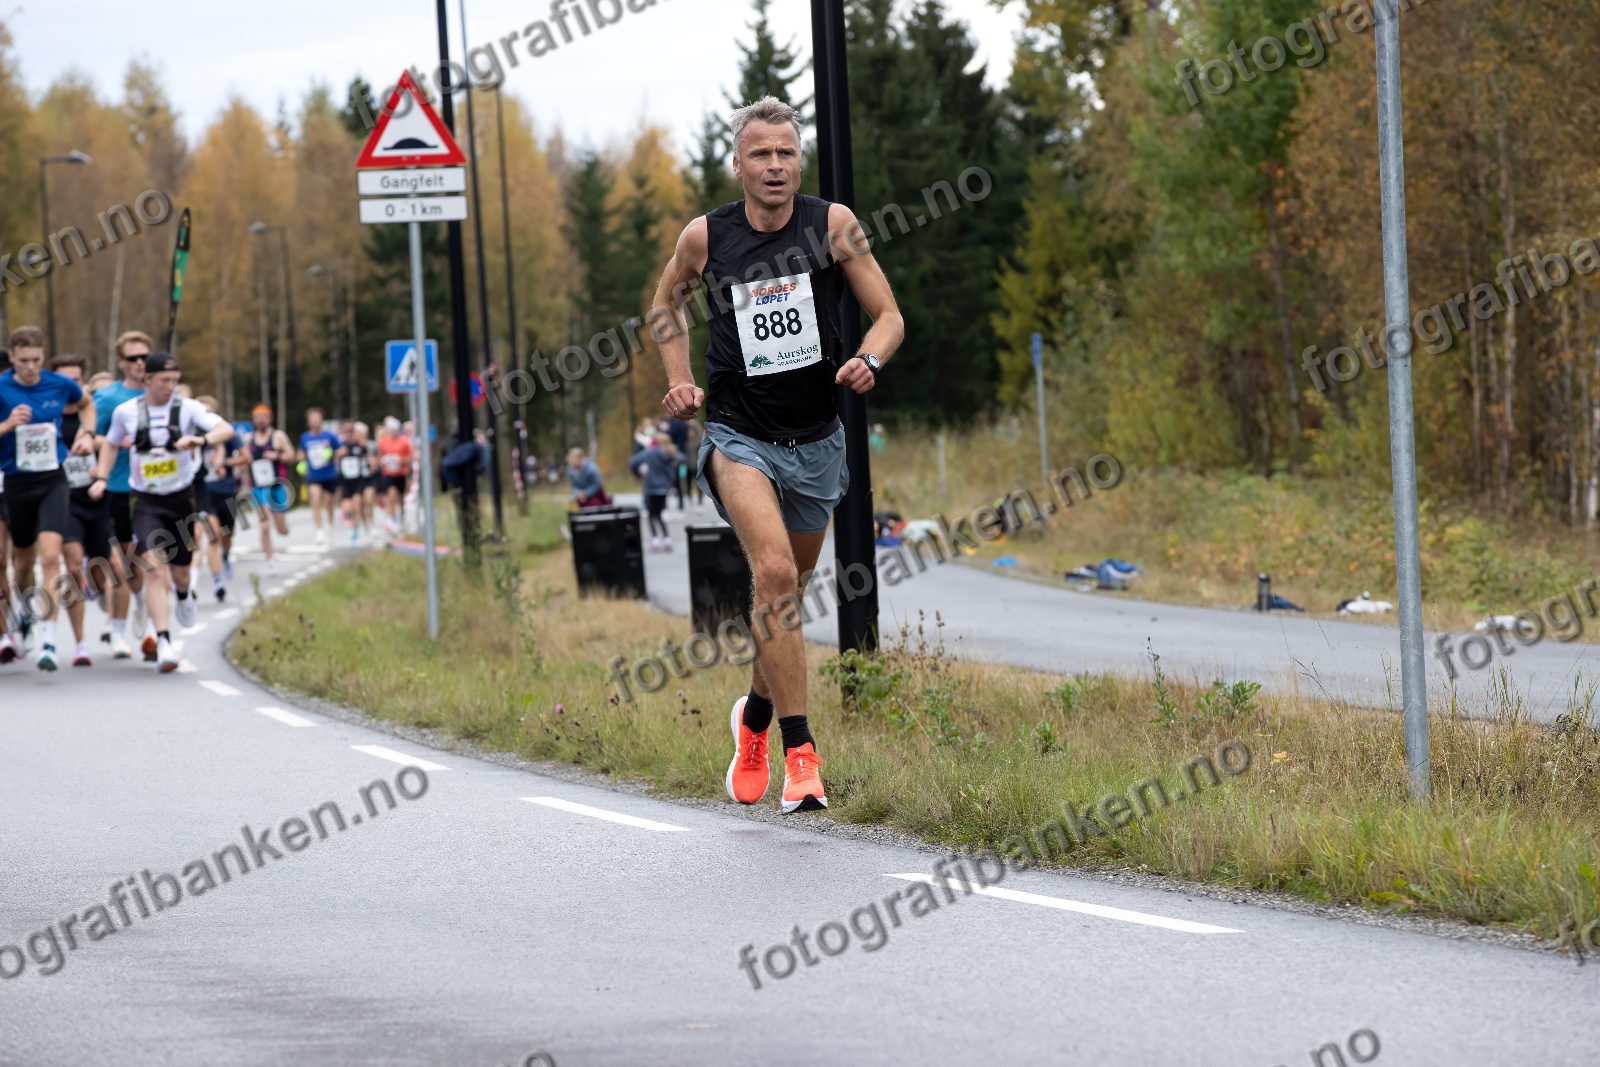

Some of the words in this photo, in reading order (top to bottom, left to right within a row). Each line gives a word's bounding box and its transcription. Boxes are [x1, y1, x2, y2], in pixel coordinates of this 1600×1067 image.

[380, 175, 444, 190] Gangfelt
[751, 282, 797, 297] NORGES
[755, 292, 791, 305] LØPET
[752, 308, 803, 341] 888
[777, 344, 819, 360] Aurskog
[25, 440, 49, 454] 965
[144, 460, 176, 477] PACE
